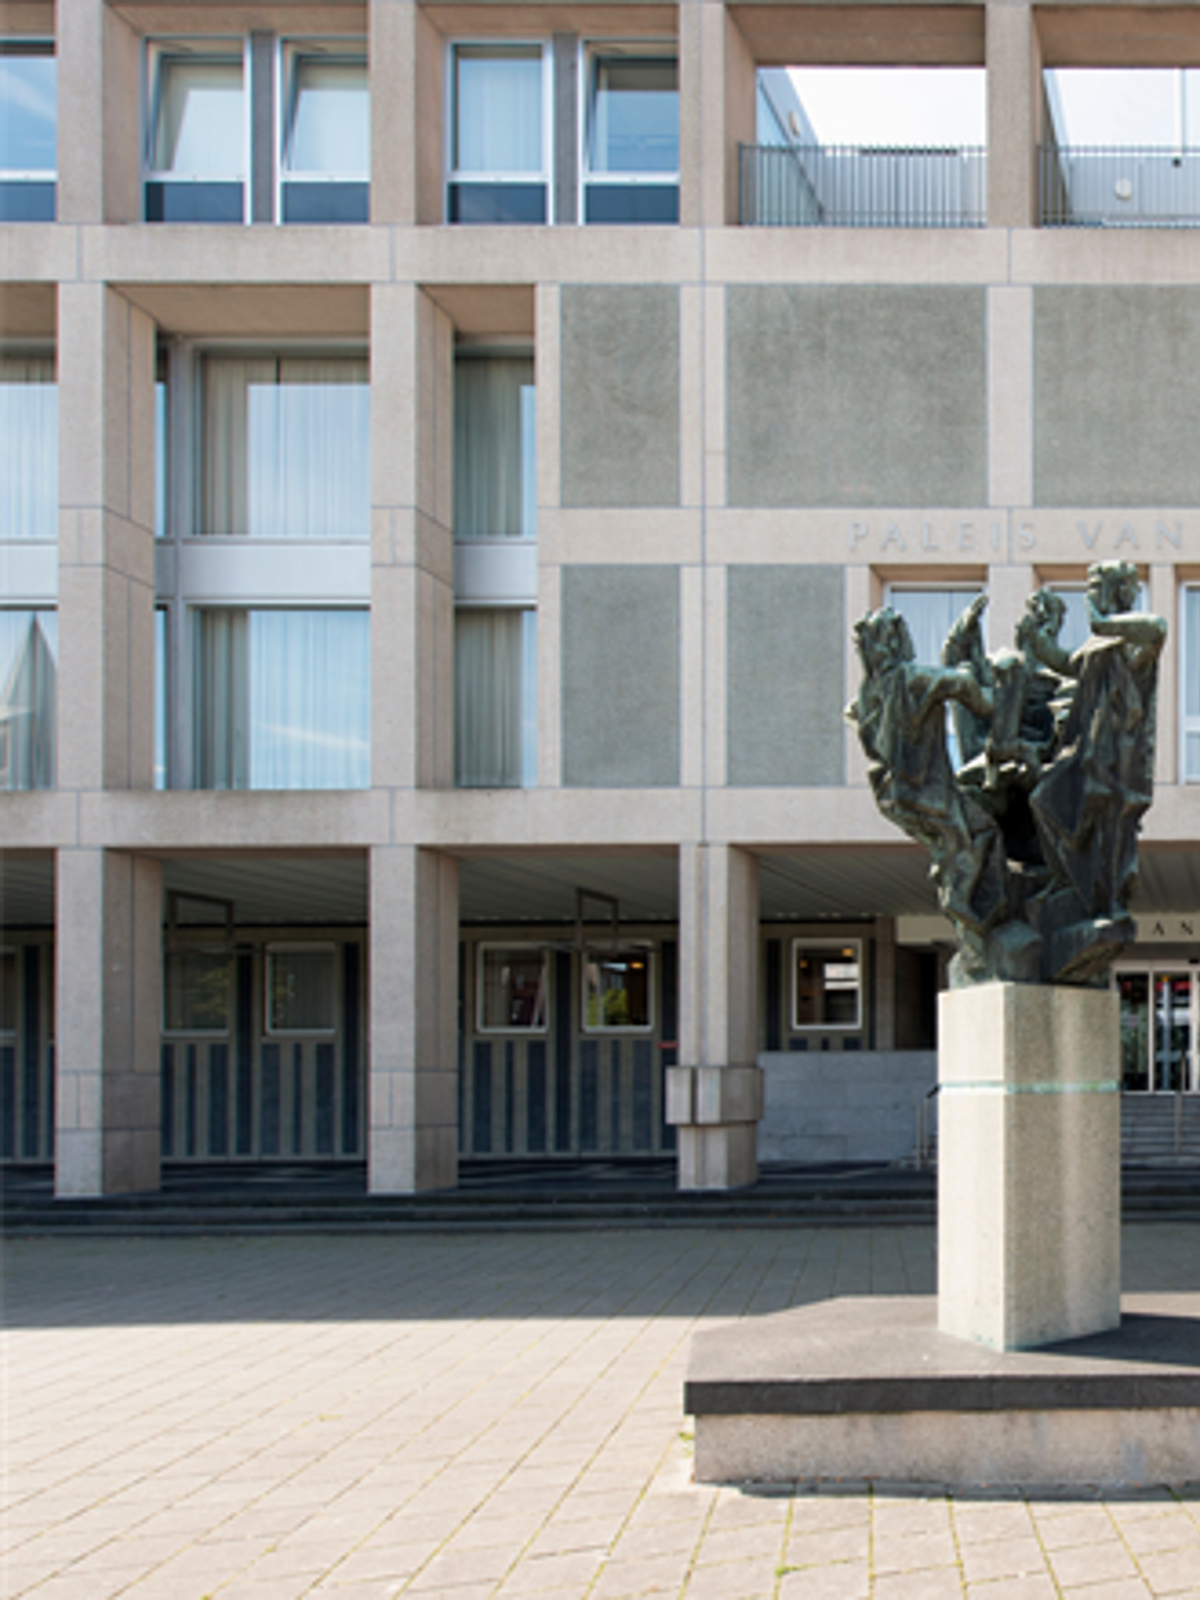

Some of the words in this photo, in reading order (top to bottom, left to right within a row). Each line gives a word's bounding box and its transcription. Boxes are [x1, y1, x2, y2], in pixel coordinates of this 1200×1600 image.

[848, 520, 1036, 552] PALEIS
[1075, 520, 1182, 550] VAN
[1151, 918, 1194, 937] AN
